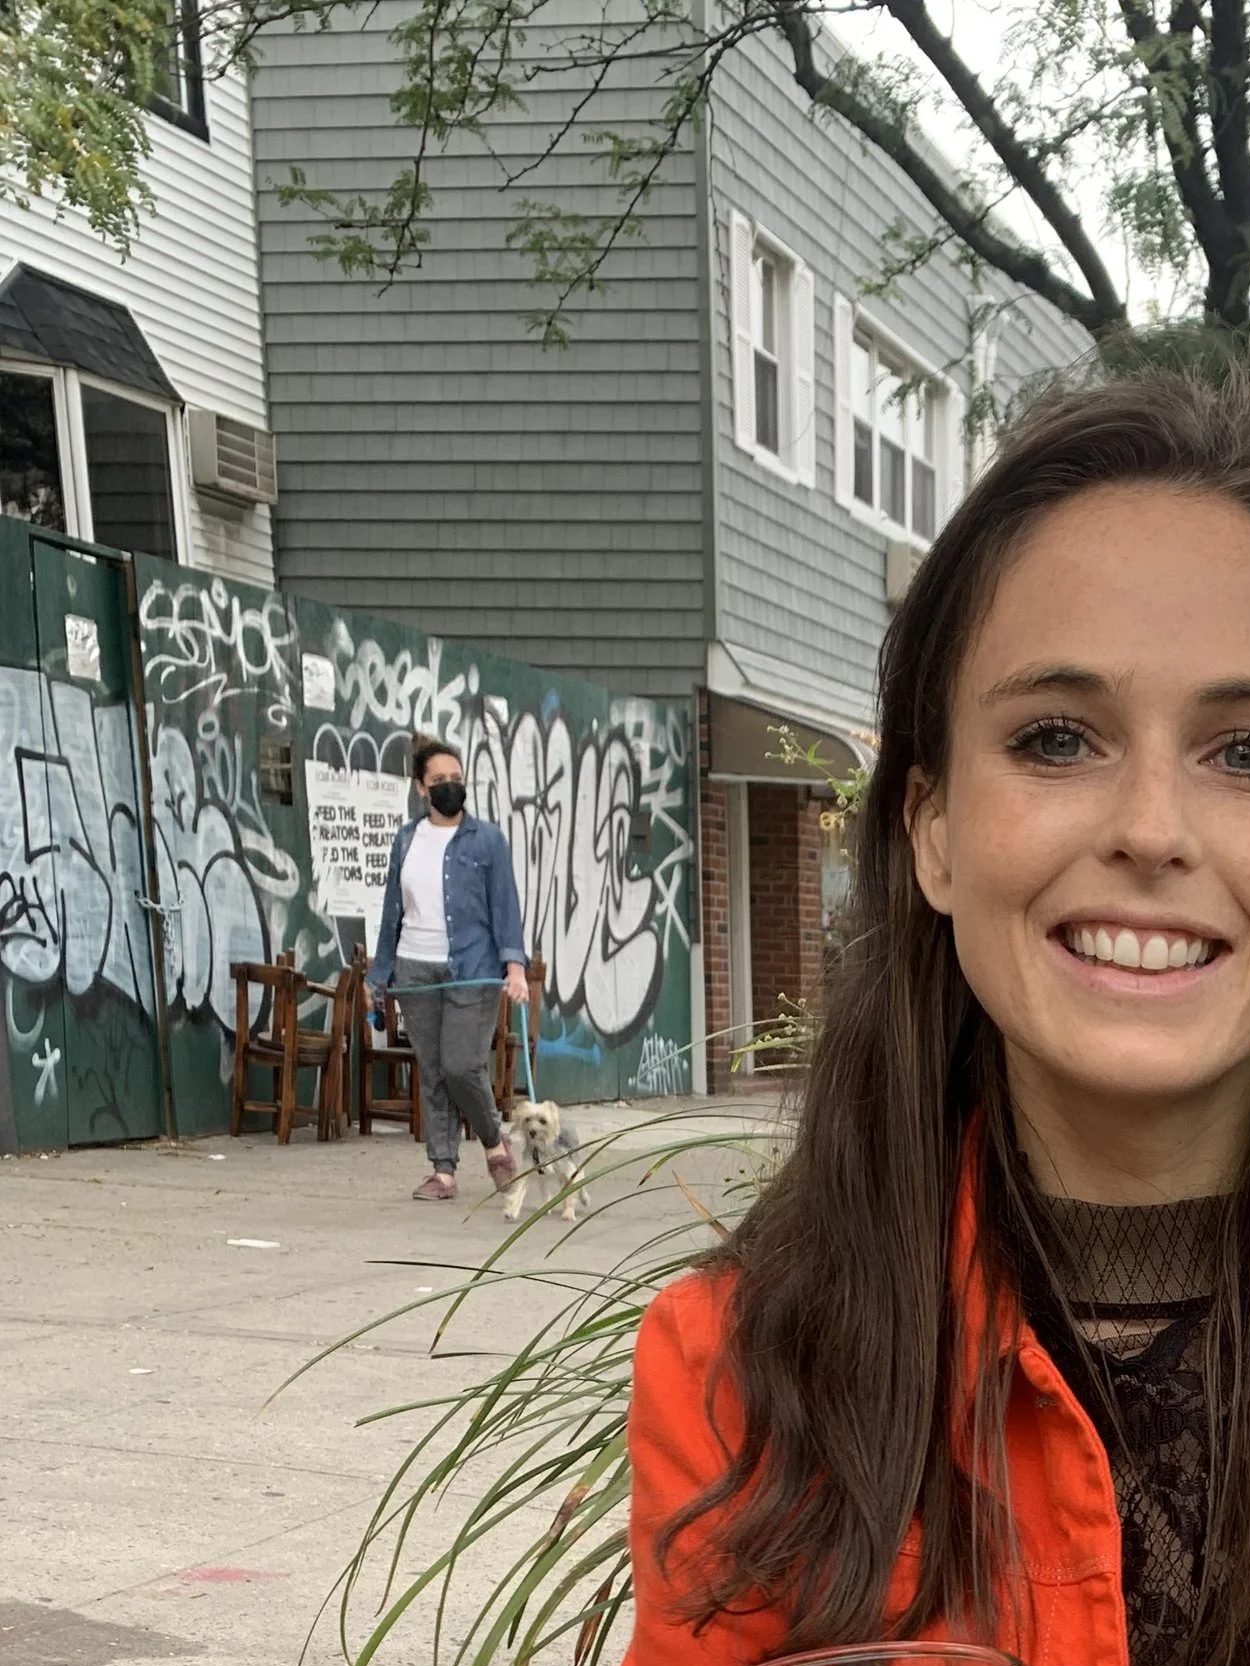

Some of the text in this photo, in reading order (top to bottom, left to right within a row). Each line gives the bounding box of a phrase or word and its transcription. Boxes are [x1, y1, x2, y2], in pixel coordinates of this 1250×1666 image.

[338, 805, 356, 822] THE
[363, 812, 404, 829] FEED THE
[362, 832, 398, 848] CREATO
[341, 846, 359, 863] THE
[365, 853, 388, 869] FEED
